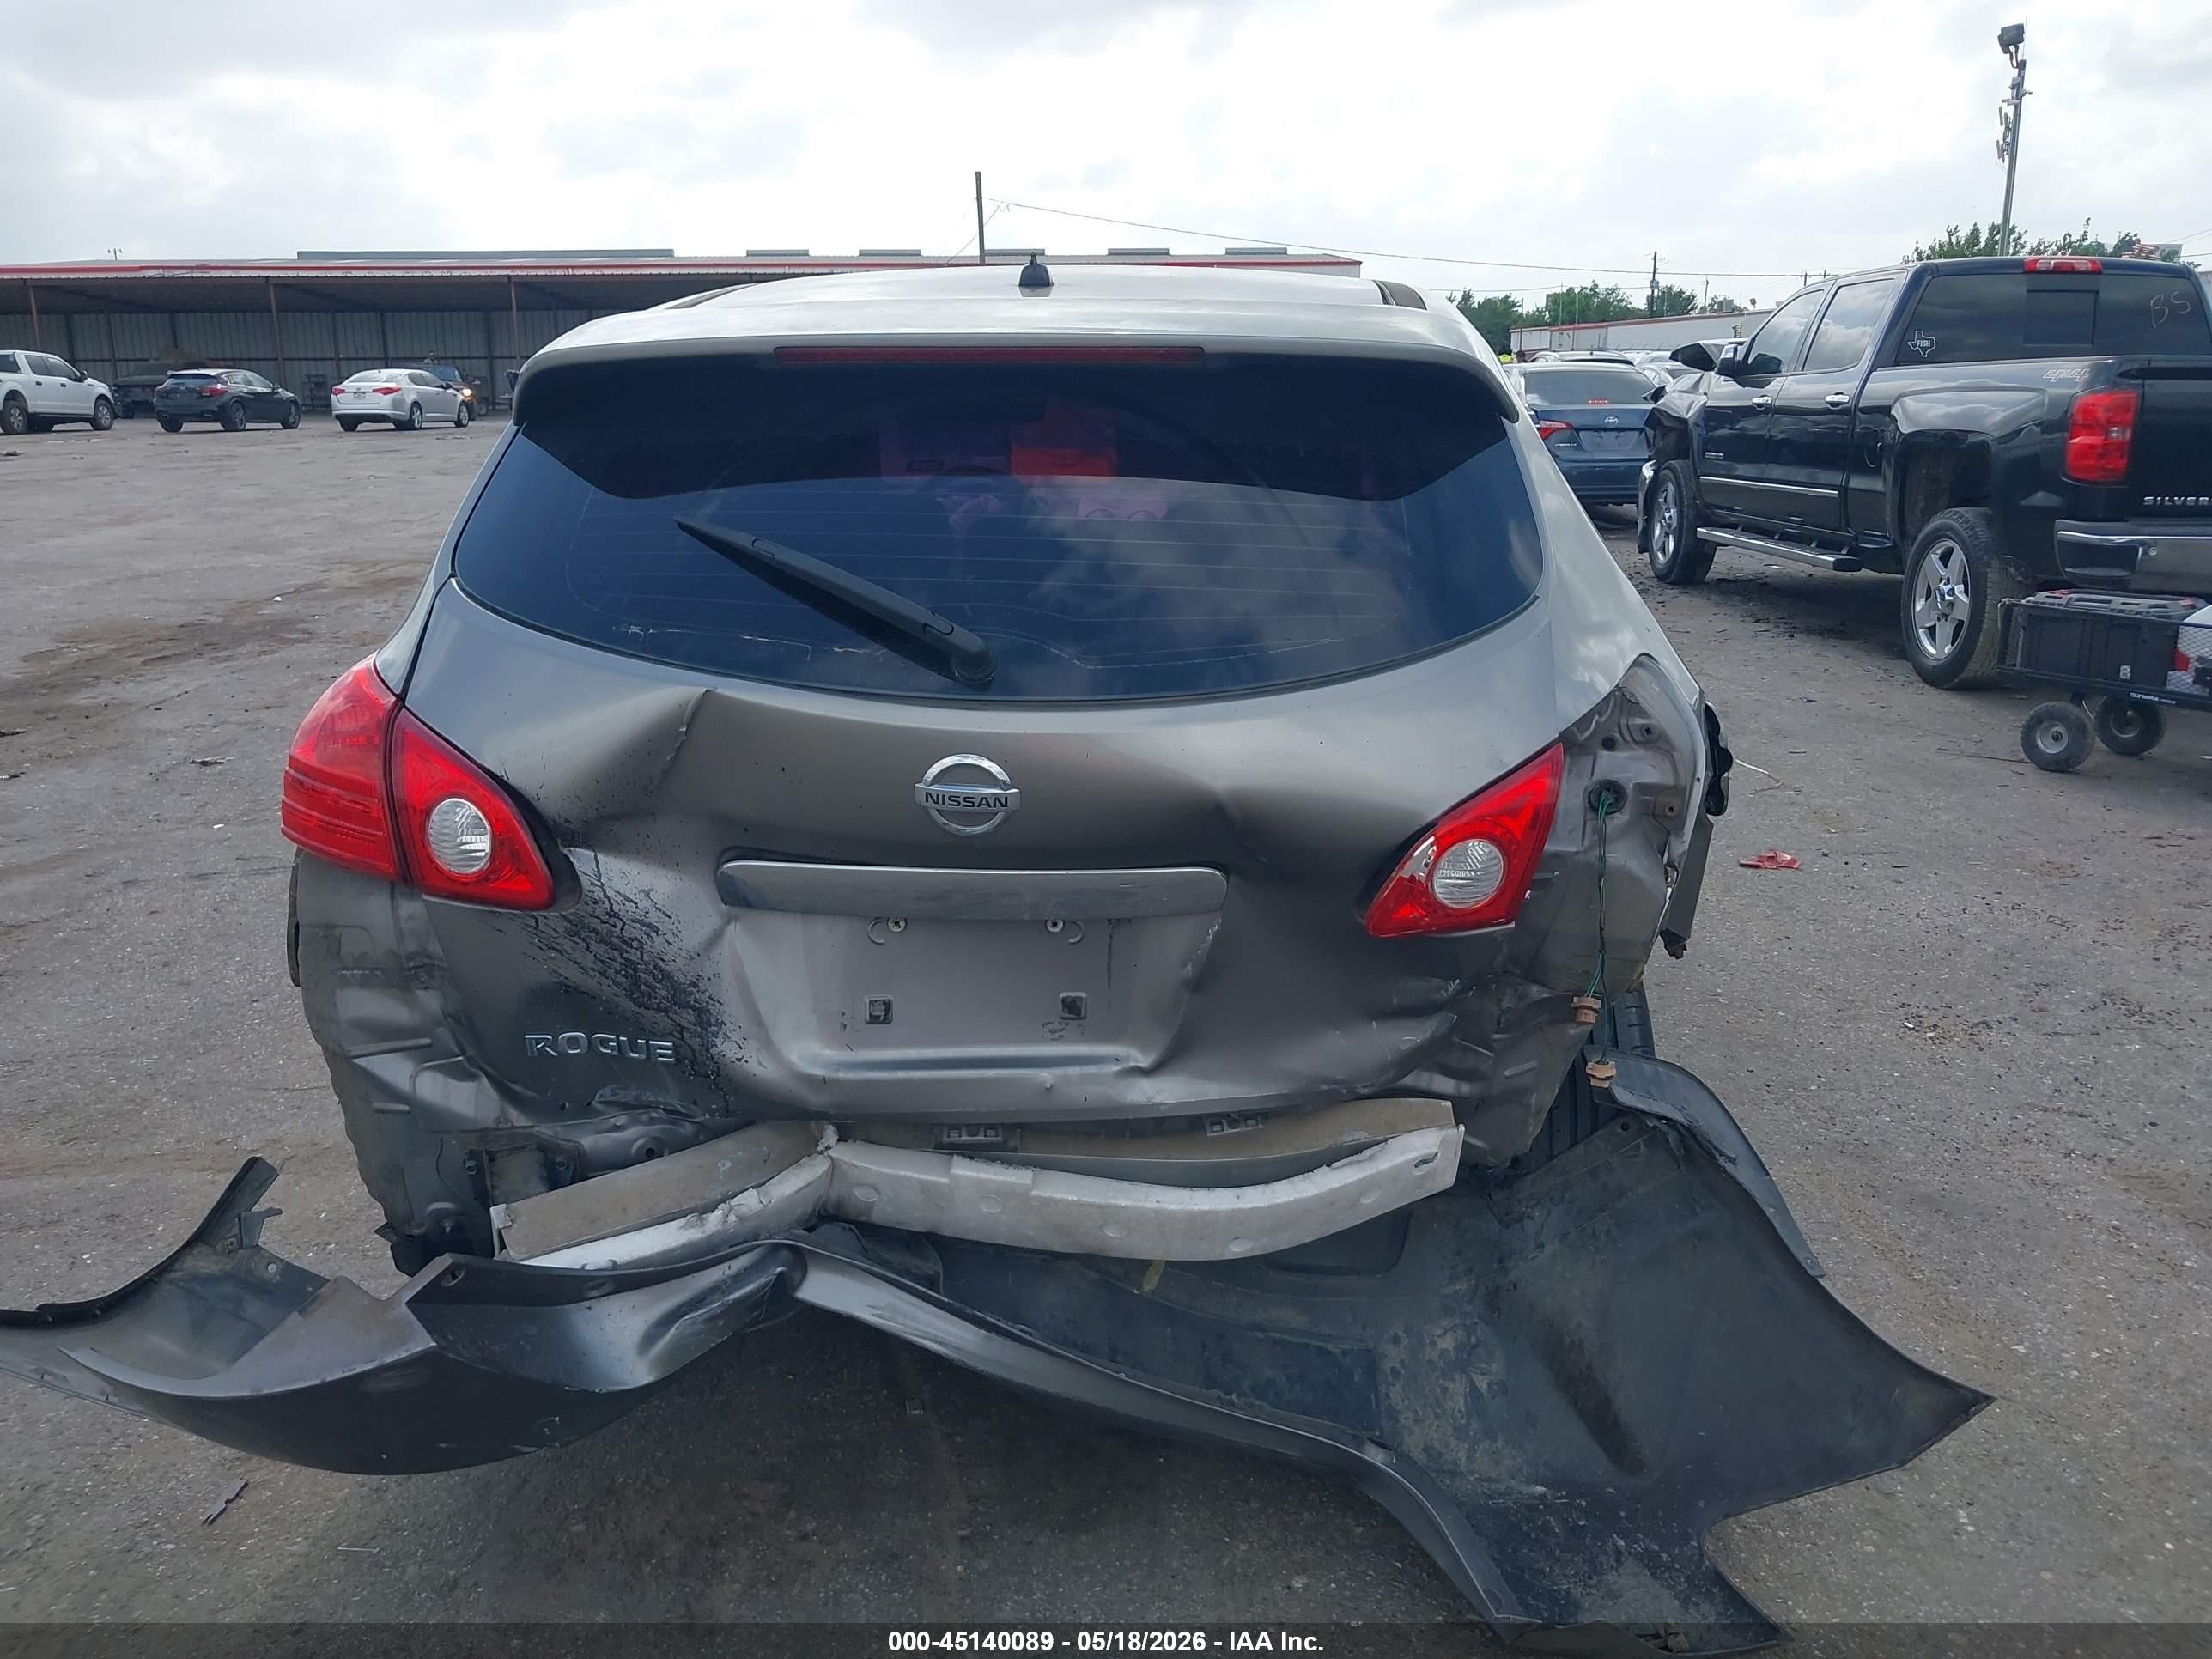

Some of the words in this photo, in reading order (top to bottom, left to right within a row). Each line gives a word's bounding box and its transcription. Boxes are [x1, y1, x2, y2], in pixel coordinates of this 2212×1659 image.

[2143, 496, 2212, 506] SILVER
[925, 792, 1008, 808] NISSAN
[524, 1032, 675, 1062] ROGUE
